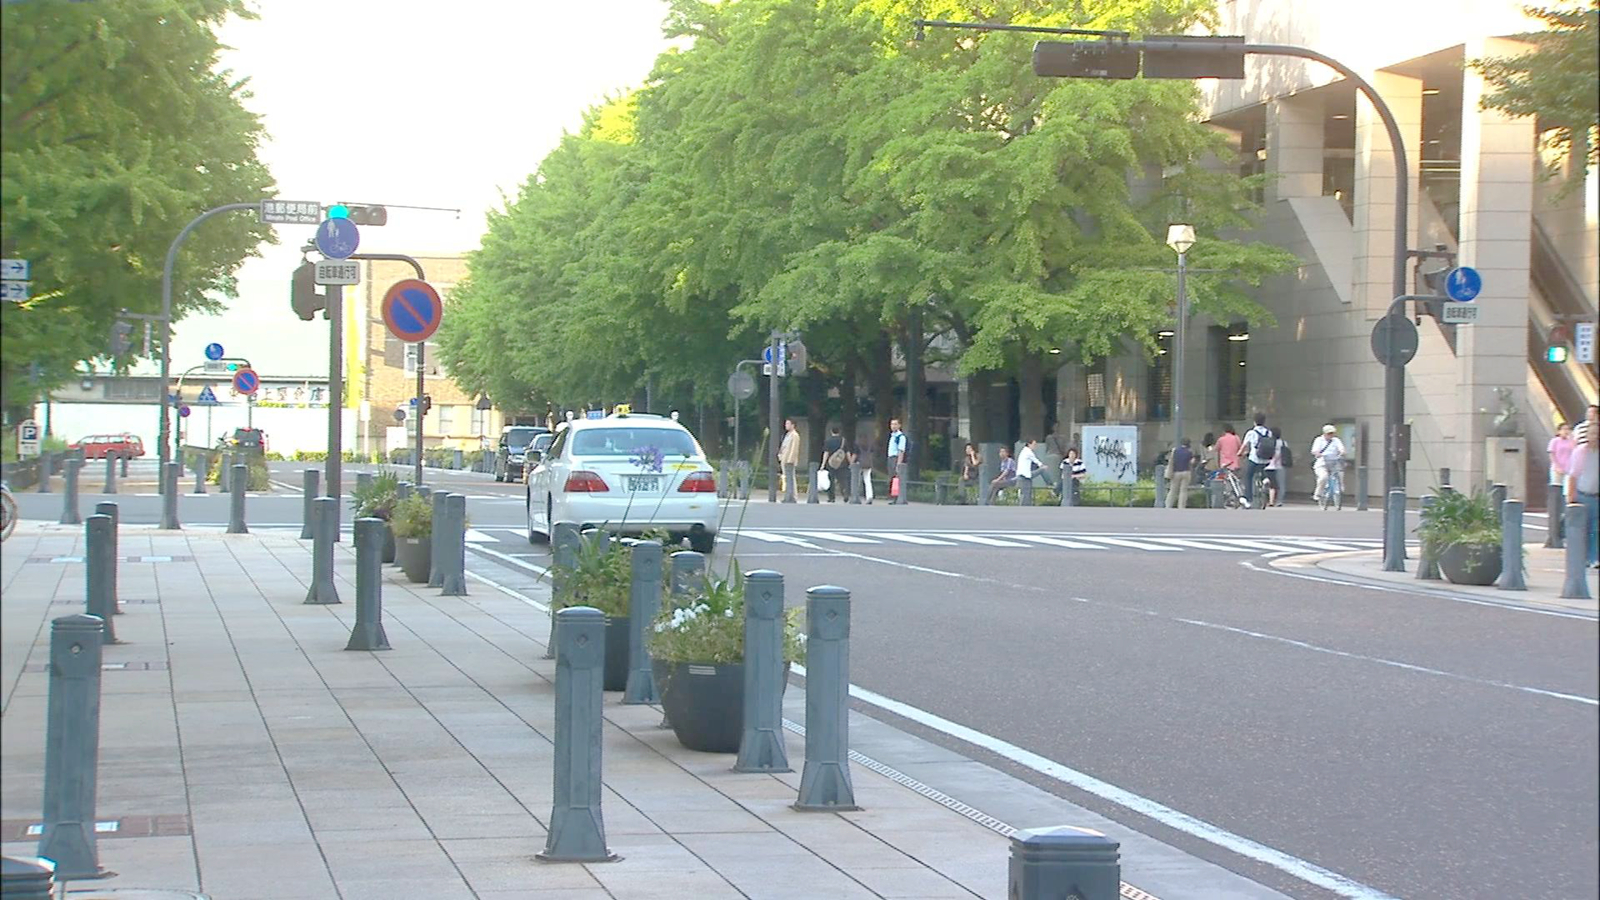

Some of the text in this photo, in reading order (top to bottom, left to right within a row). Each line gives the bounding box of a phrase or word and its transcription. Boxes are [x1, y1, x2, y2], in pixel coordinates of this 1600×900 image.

[319, 265, 356, 279] 自転車通行可
[25, 427, 36, 438] P
